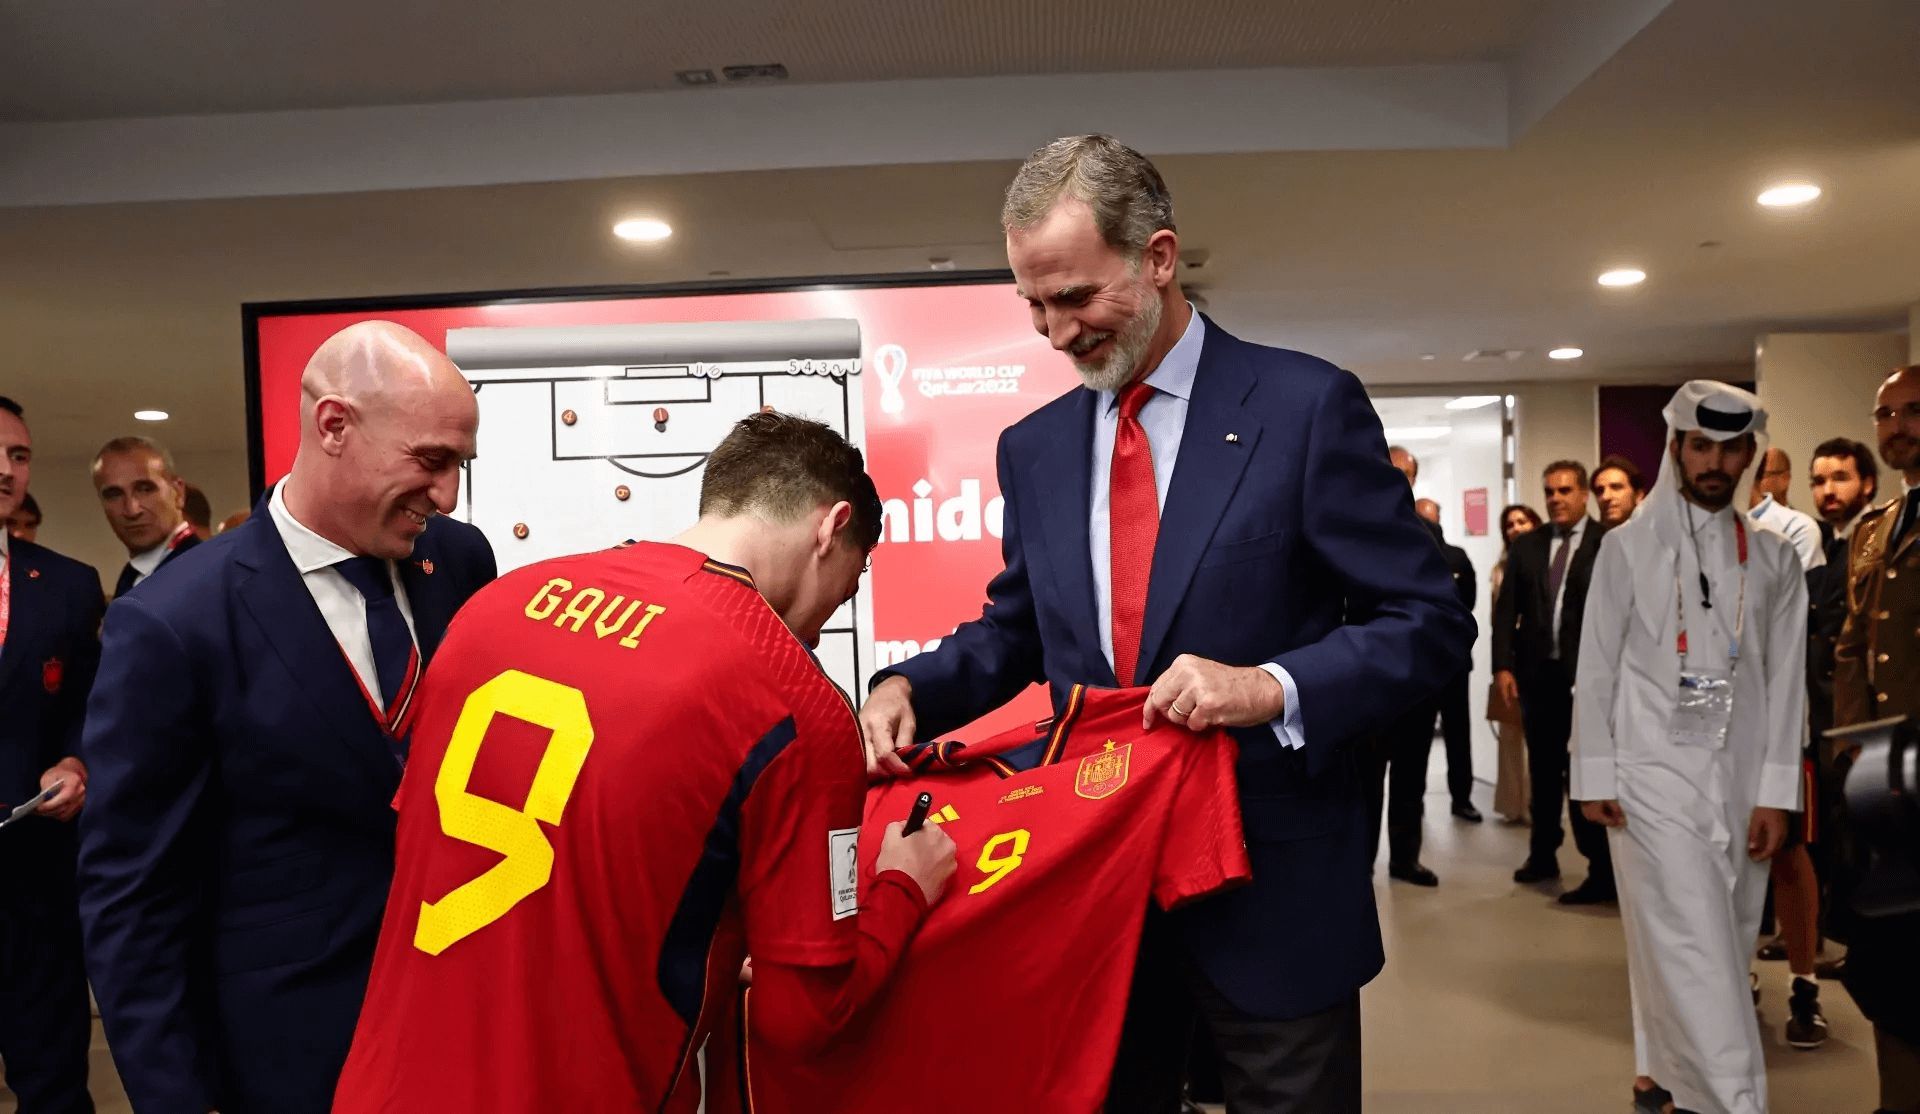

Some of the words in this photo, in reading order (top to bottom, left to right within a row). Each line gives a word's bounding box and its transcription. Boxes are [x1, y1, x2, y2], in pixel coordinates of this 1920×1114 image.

[911, 367, 943, 380] FIFA
[944, 365, 995, 380] WORLD
[997, 364, 1026, 378] CUP
[525, 577, 667, 649] GAVI
[413, 669, 595, 956] 9
[968, 828, 1031, 895] 9
